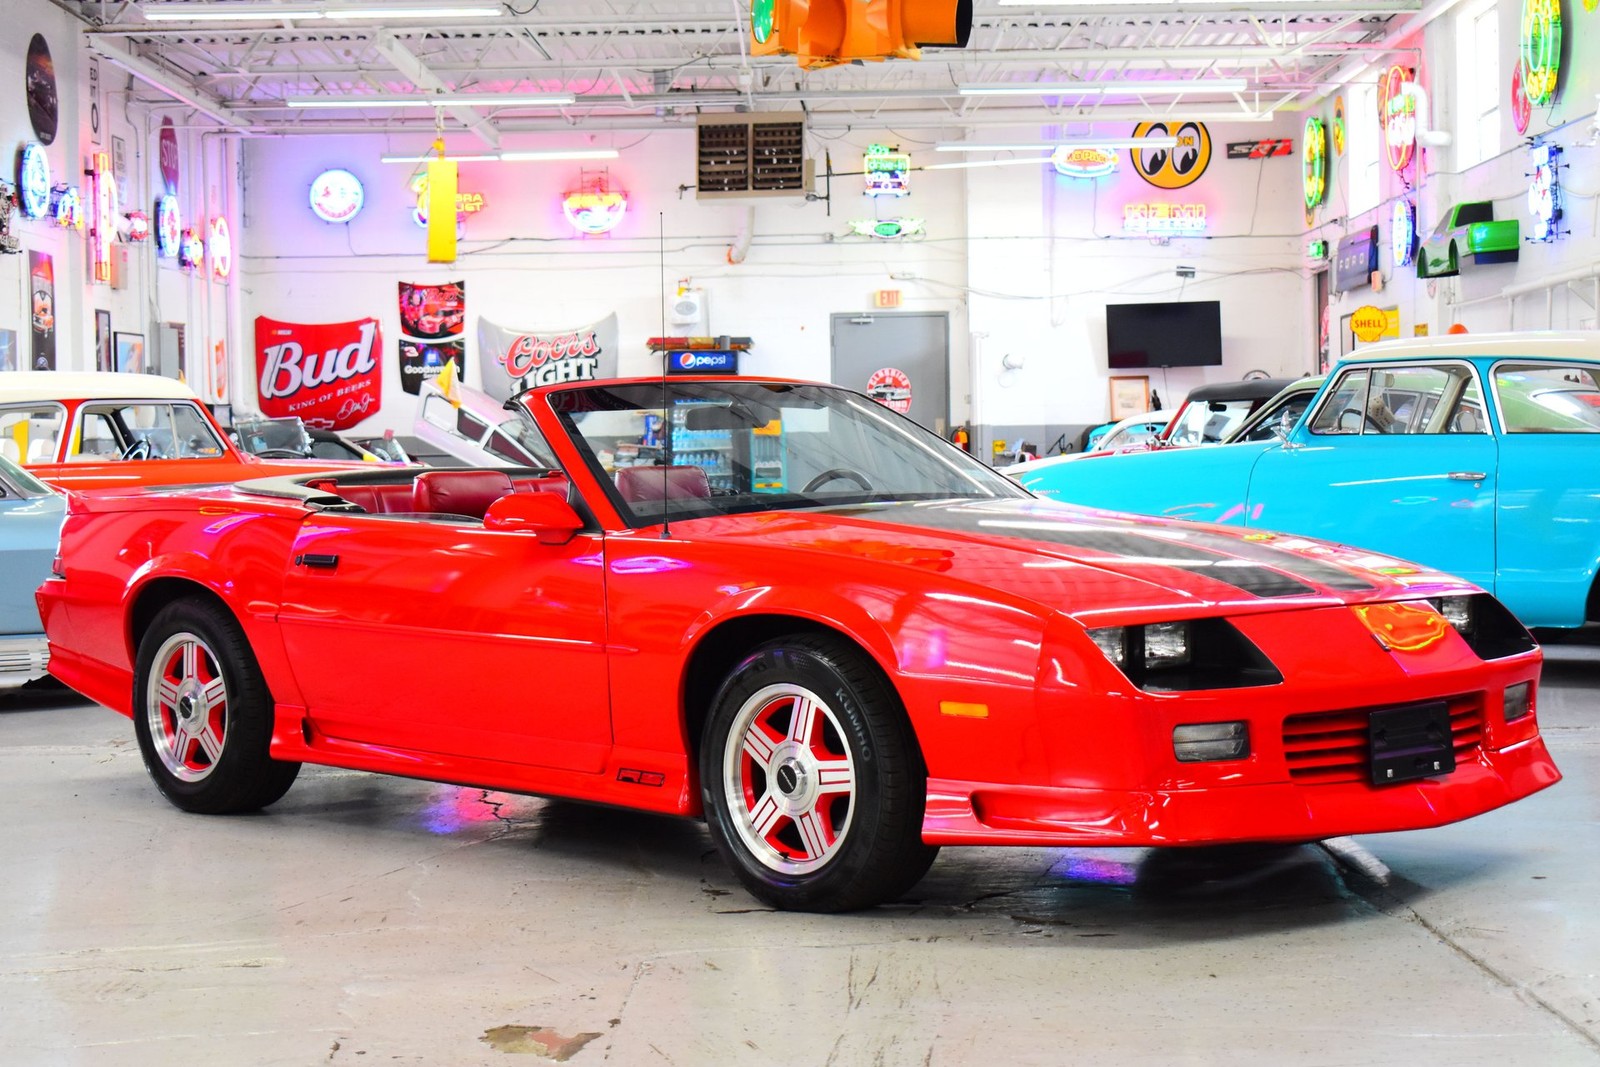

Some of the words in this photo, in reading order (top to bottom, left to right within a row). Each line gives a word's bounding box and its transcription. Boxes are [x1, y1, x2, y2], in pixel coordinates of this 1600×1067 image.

[162, 139, 178, 169] STOP
[1229, 141, 1291, 155] SRT
[456, 193, 482, 202] BRA
[1339, 252, 1365, 270] FORD
[880, 290, 900, 306] EXIT
[1354, 319, 1382, 328] SHELL
[260, 321, 377, 399] Bud
[498, 330, 601, 378] Coors
[696, 355, 726, 366] pepsi
[288, 399, 315, 412] KING
[319, 393, 333, 403] OF
[336, 380, 371, 397] BEERS
[835, 688, 871, 762] KUMHO
